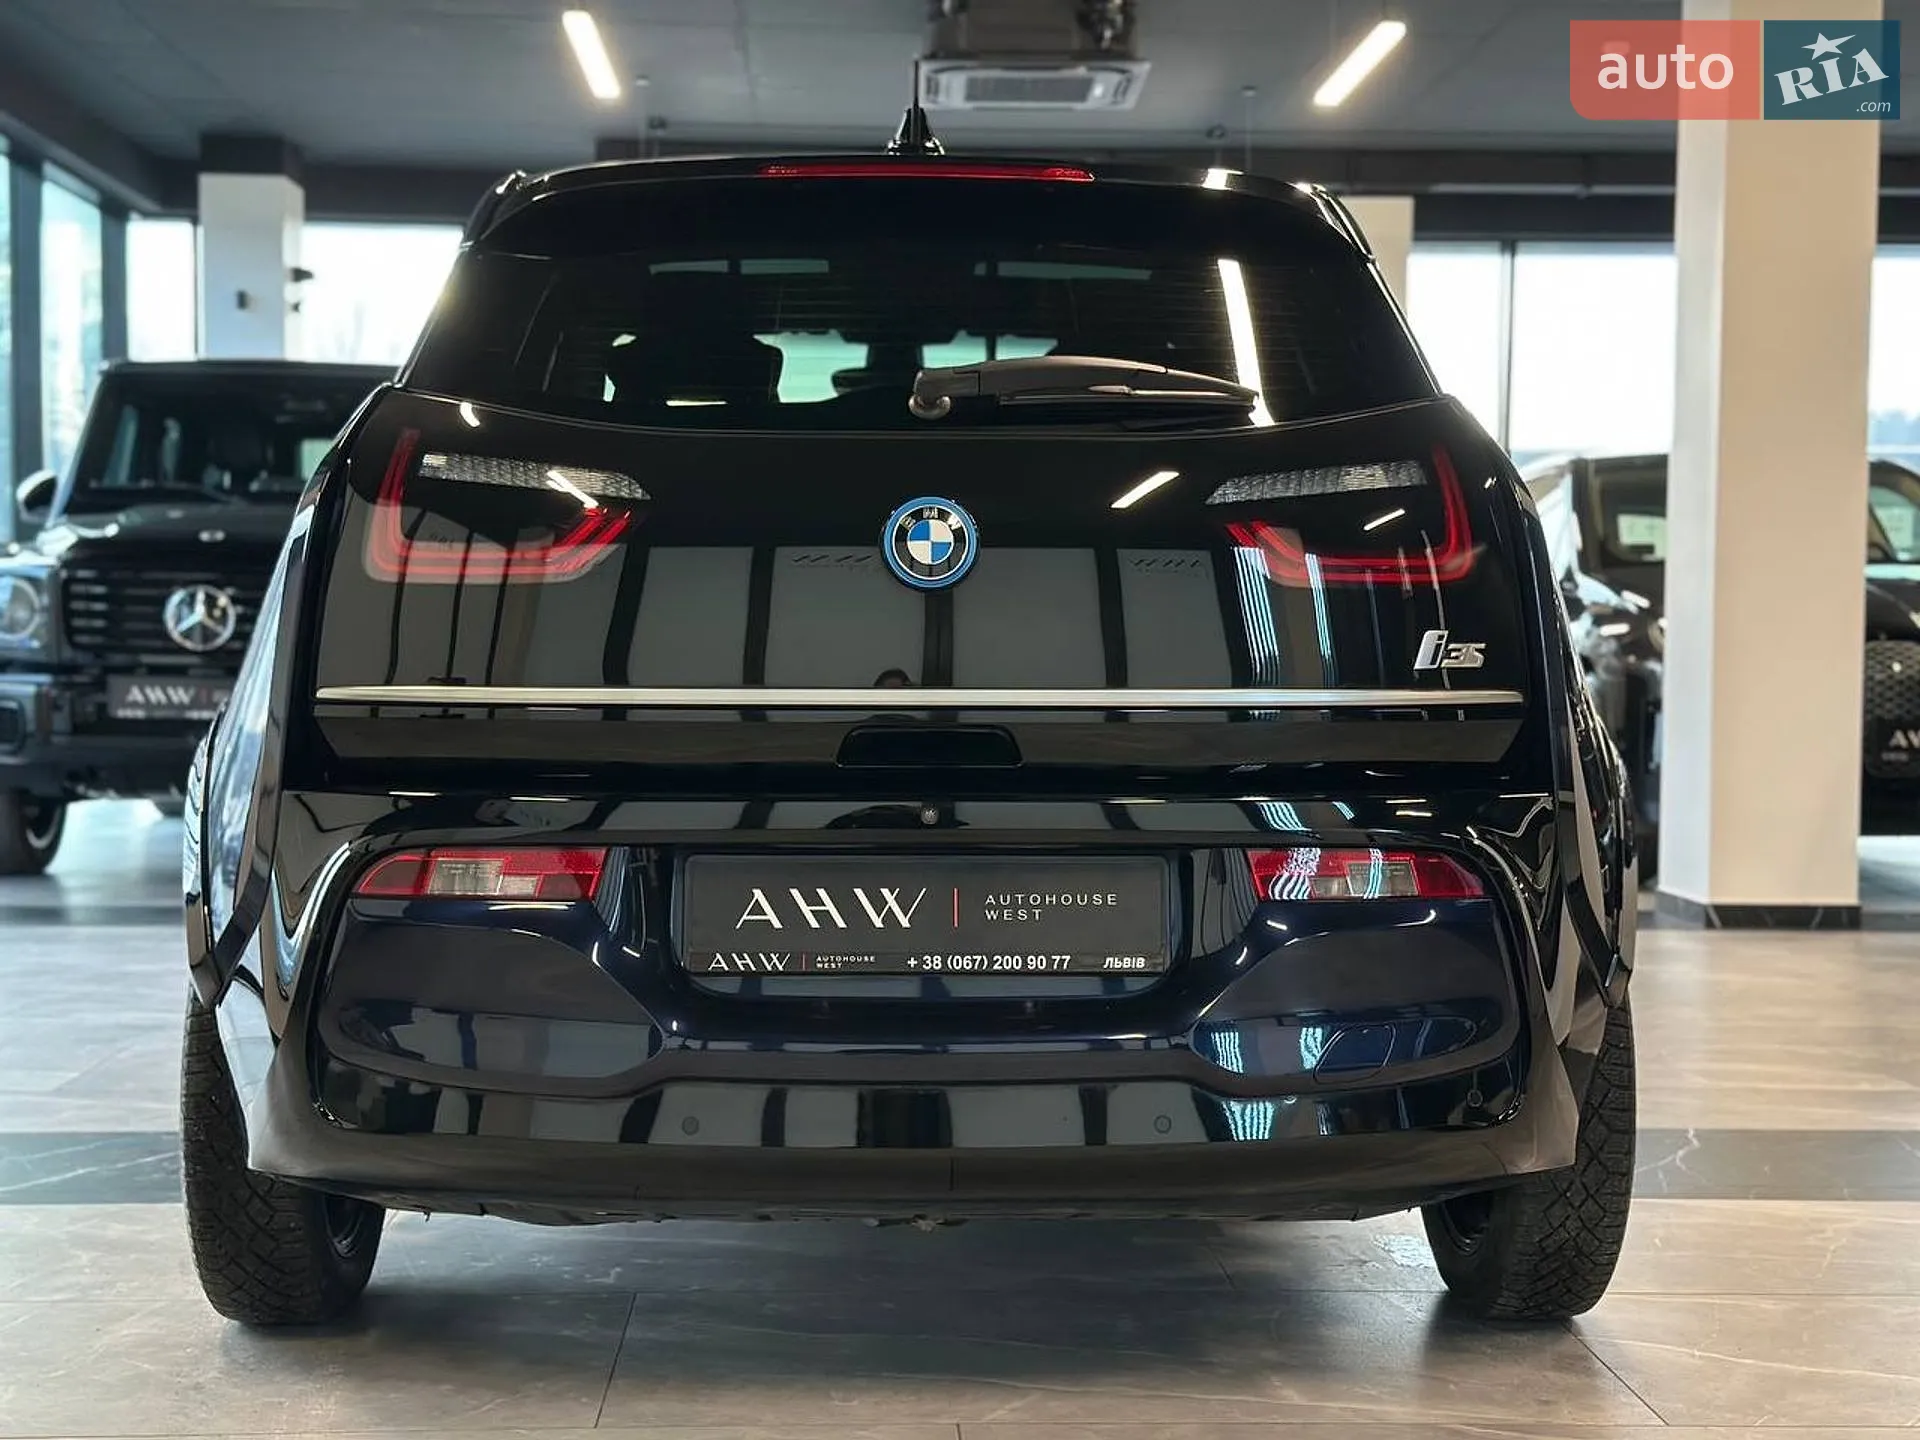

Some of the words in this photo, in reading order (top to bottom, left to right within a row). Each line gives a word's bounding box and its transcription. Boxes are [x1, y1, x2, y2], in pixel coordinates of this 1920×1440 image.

[985, 894, 1117, 906] AUTOHOUSE
[735, 887, 927, 929] AHW
[985, 909, 1042, 921] WEST
[708, 952, 791, 971] AHW
[816, 955, 876, 963] AUTOHOUSE
[922, 955, 942, 970] 38
[947, 955, 988, 970] (067)
[992, 955, 1023, 970] 200
[1027, 955, 1047, 970] 90
[1051, 955, 1071, 970] 77
